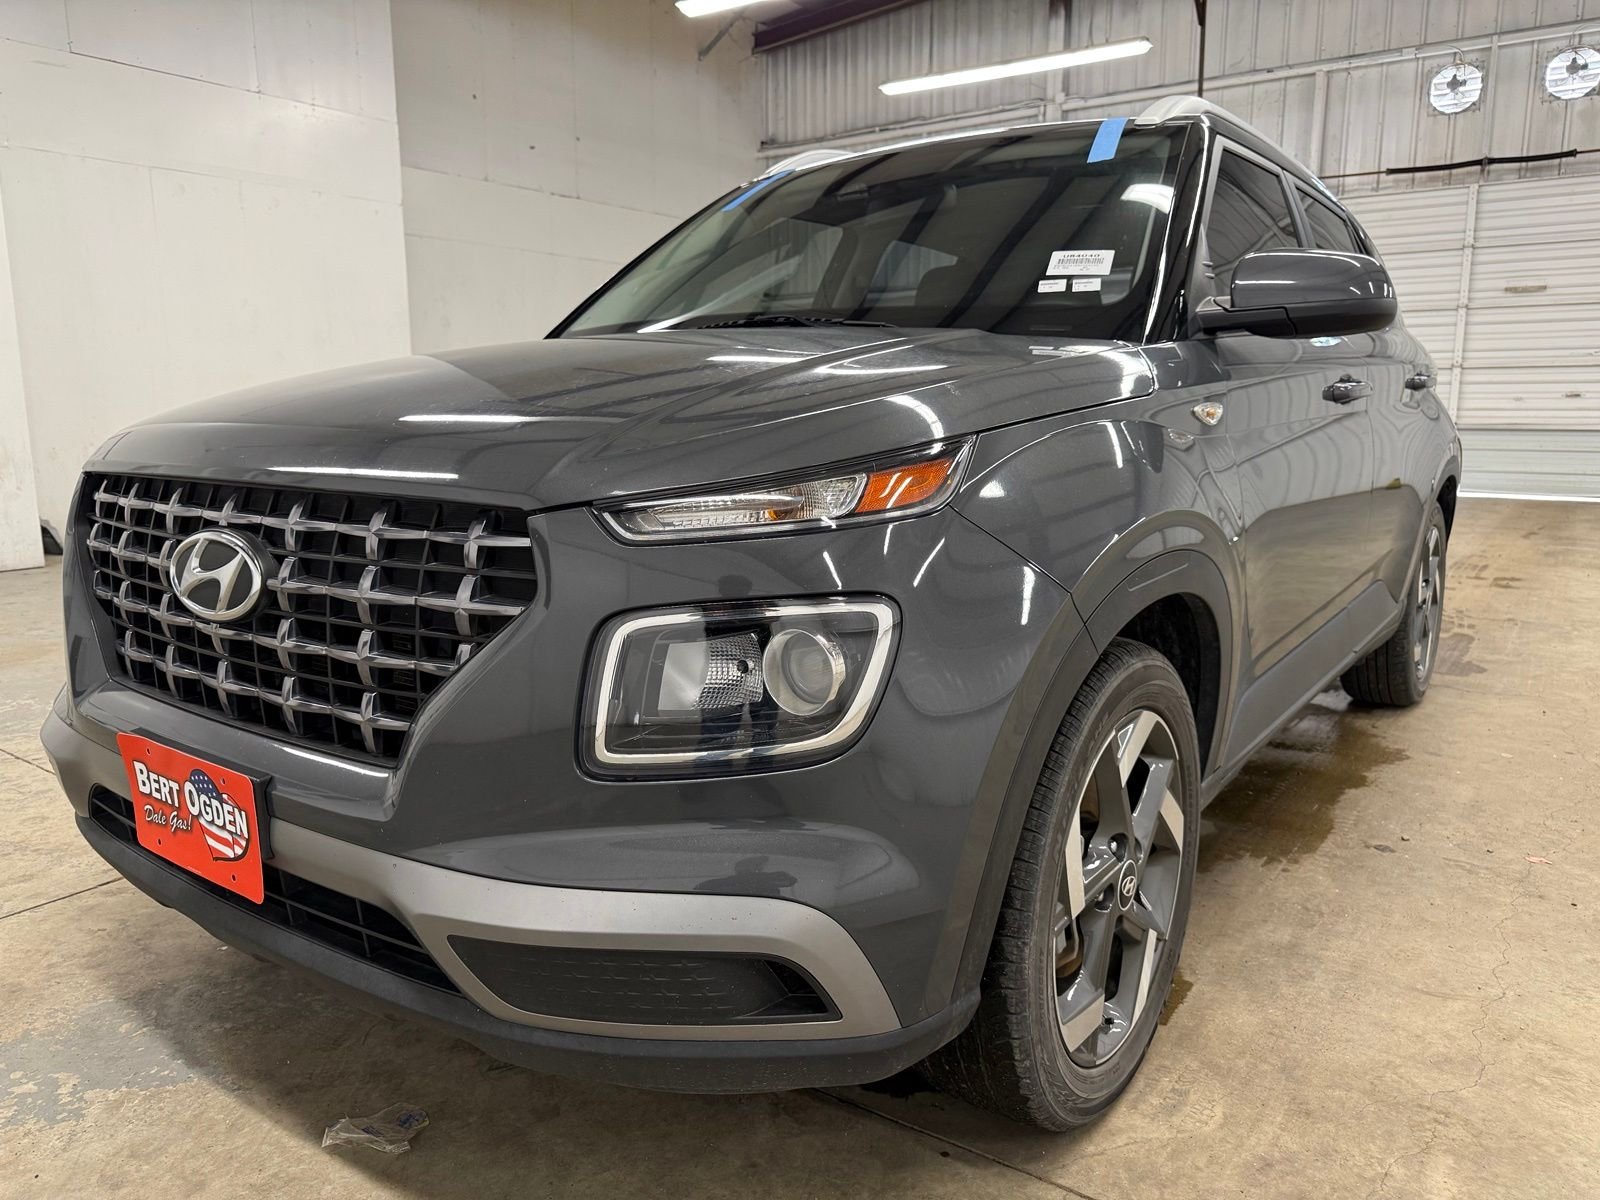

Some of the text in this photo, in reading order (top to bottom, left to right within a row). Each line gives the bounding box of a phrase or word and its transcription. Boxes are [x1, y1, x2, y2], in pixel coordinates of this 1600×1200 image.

[132, 760, 249, 840] BERT OGDEN
[144, 804, 192, 833] Dale Gas!
